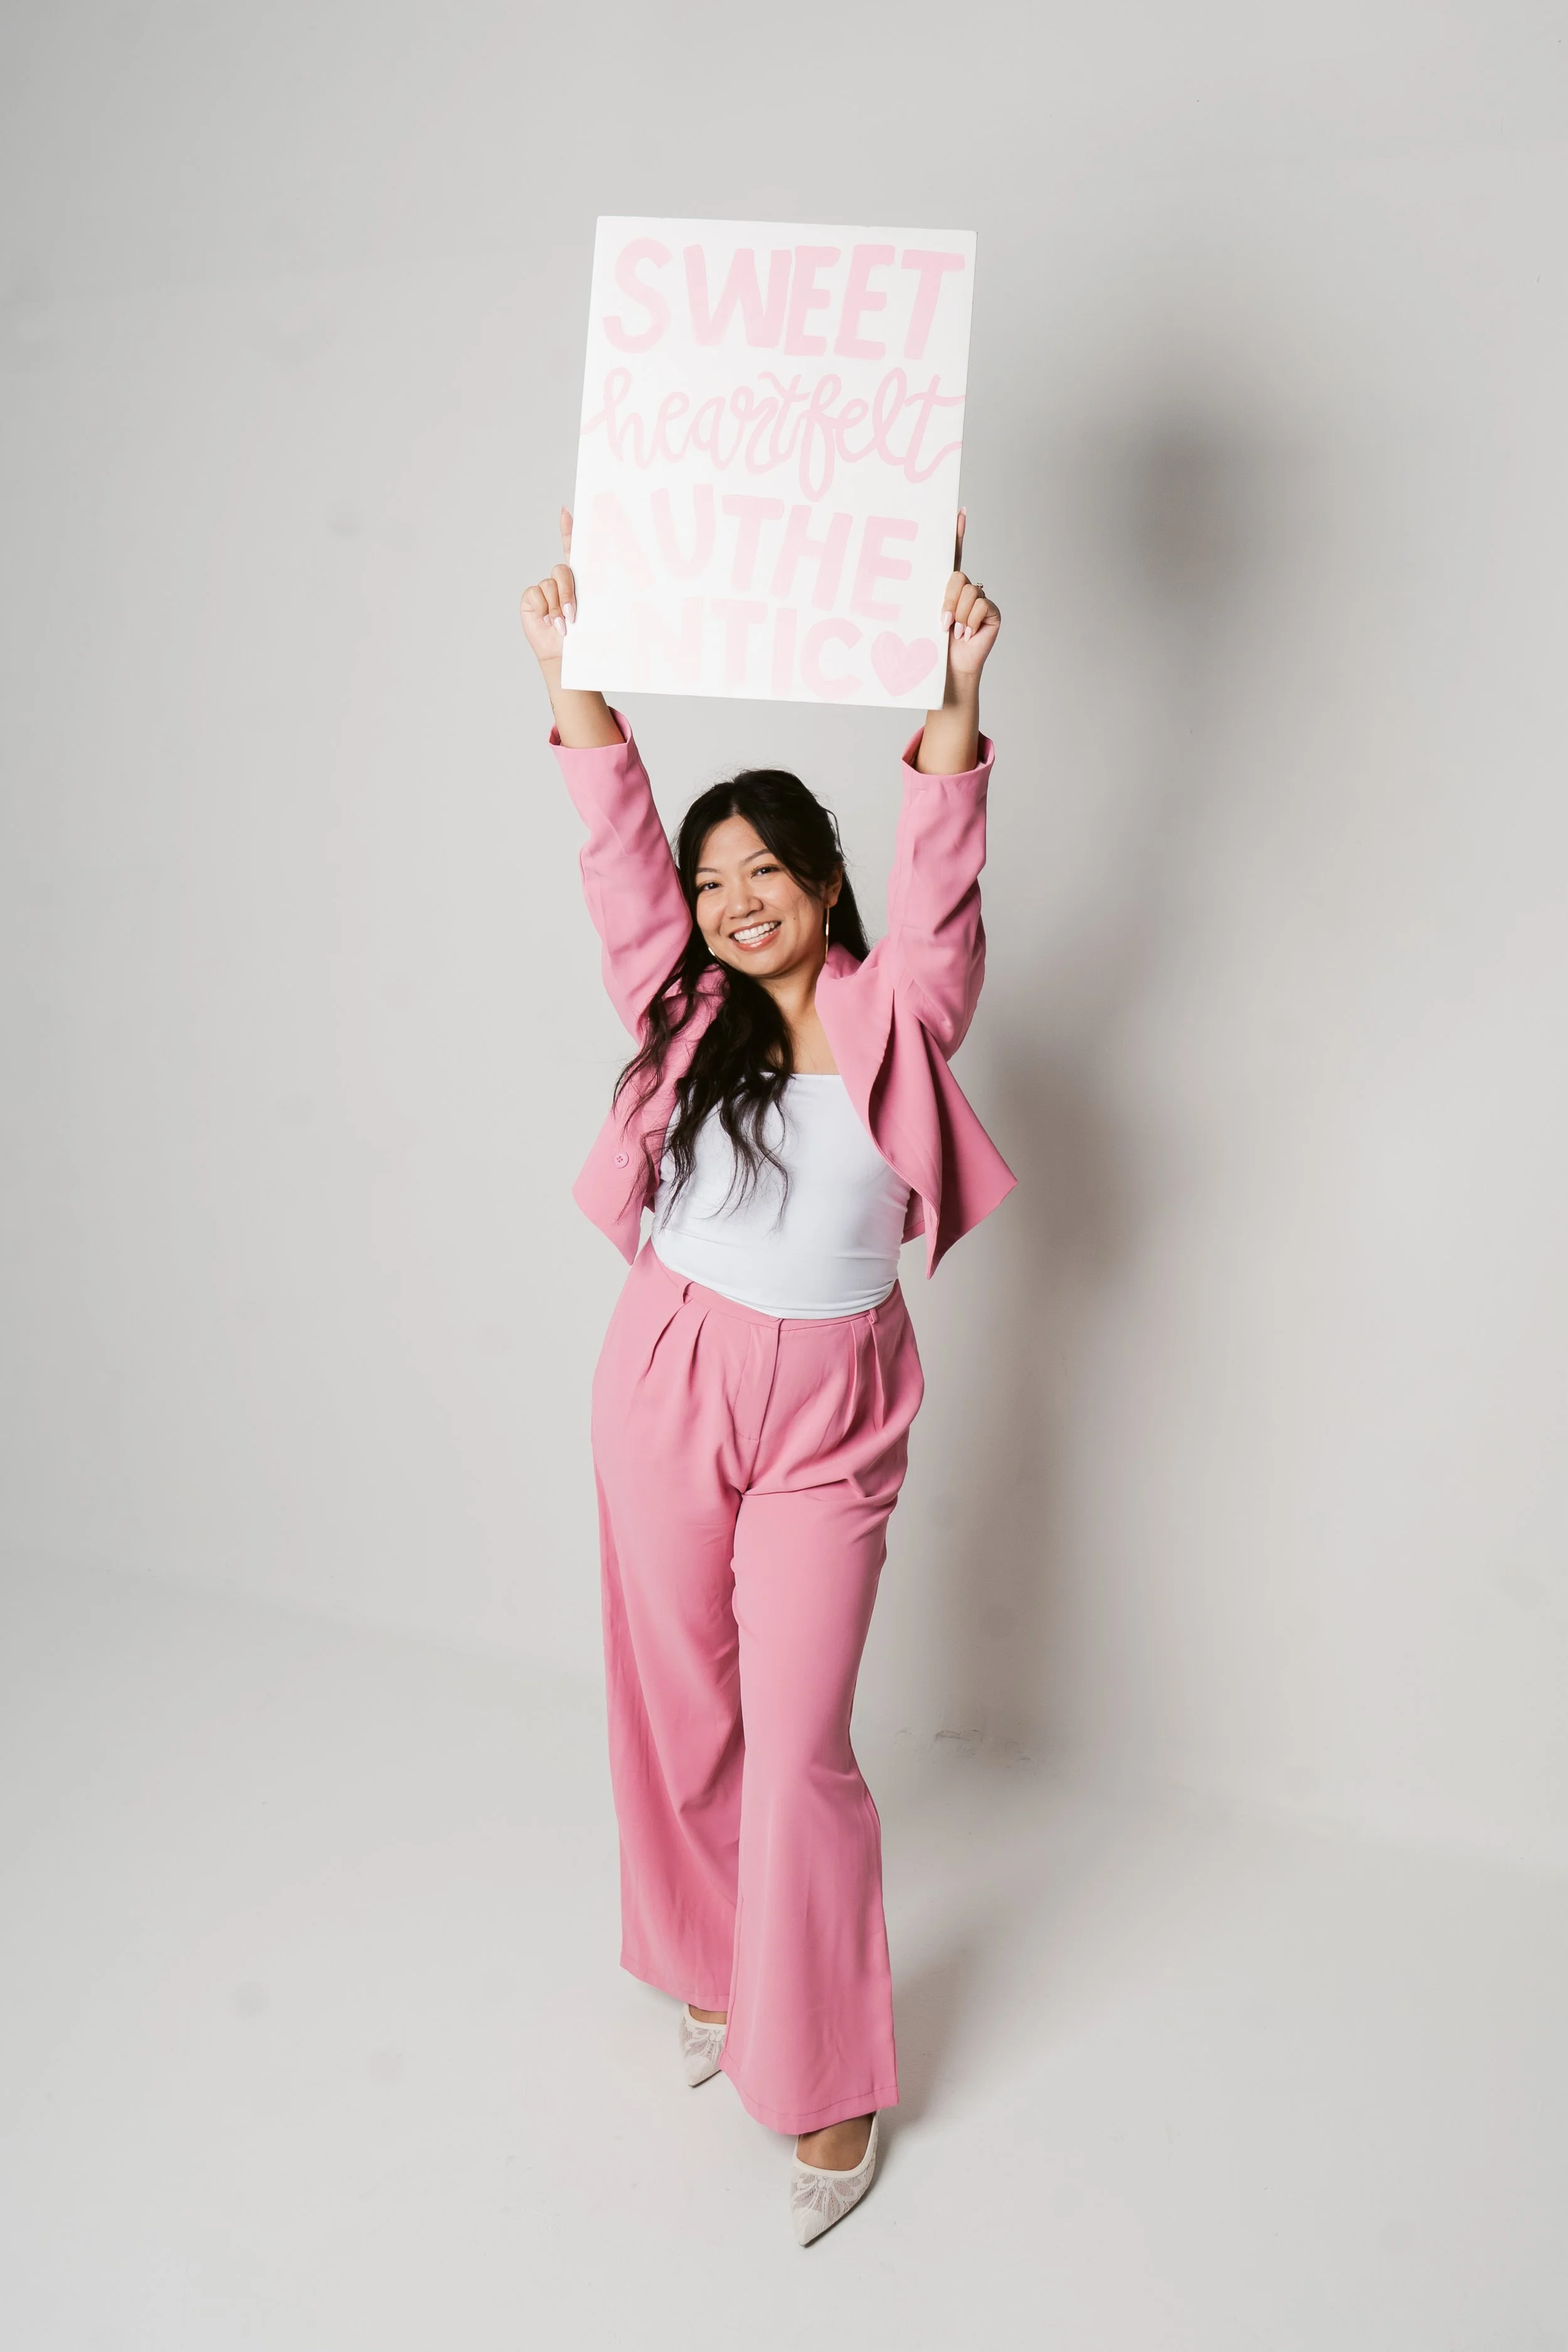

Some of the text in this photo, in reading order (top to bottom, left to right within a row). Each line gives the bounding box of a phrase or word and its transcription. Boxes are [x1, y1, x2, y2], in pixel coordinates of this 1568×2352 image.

[603, 236, 966, 359] SWEET
[579, 367, 967, 501] heartfelt
[585, 484, 918, 621] AUTHE
[628, 595, 864, 700] NTIC
